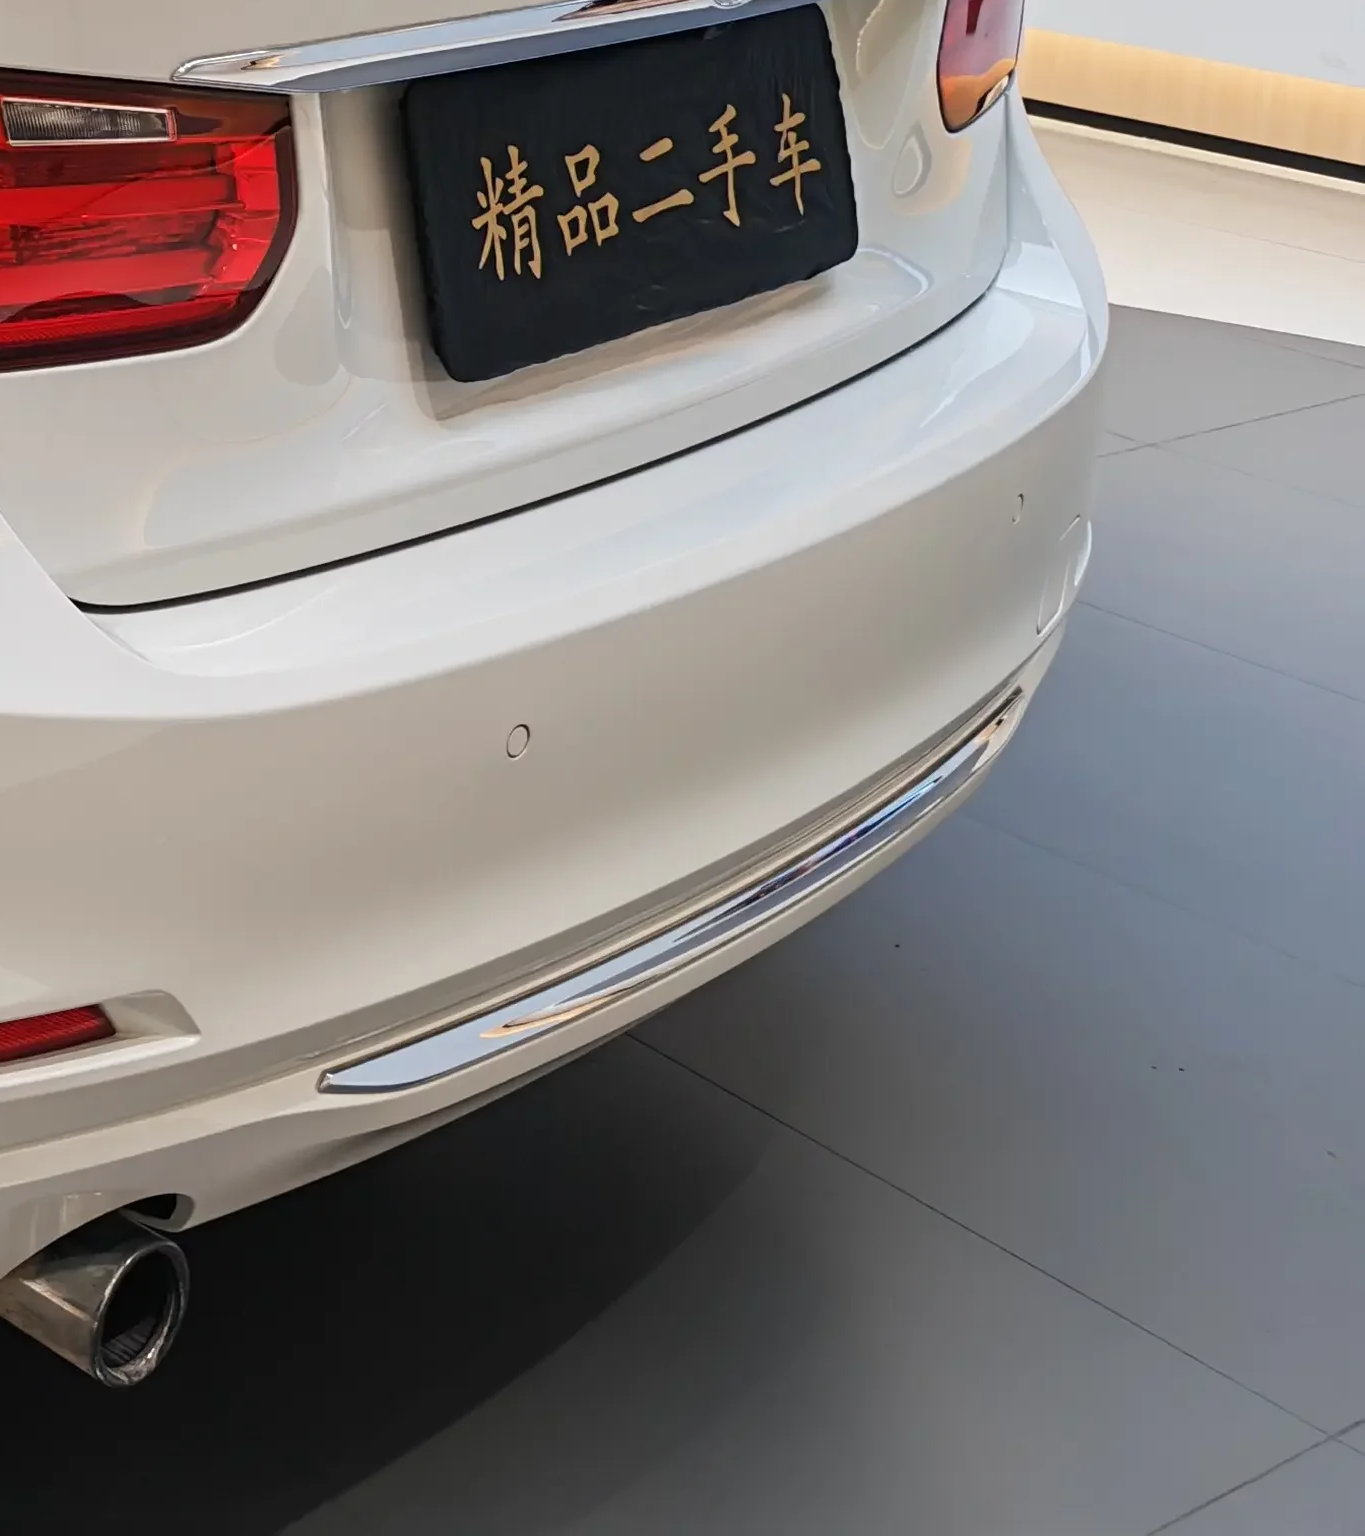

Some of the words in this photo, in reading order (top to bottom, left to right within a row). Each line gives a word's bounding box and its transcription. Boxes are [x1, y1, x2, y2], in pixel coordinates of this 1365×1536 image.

[471, 93, 822, 281] 精品二手车
